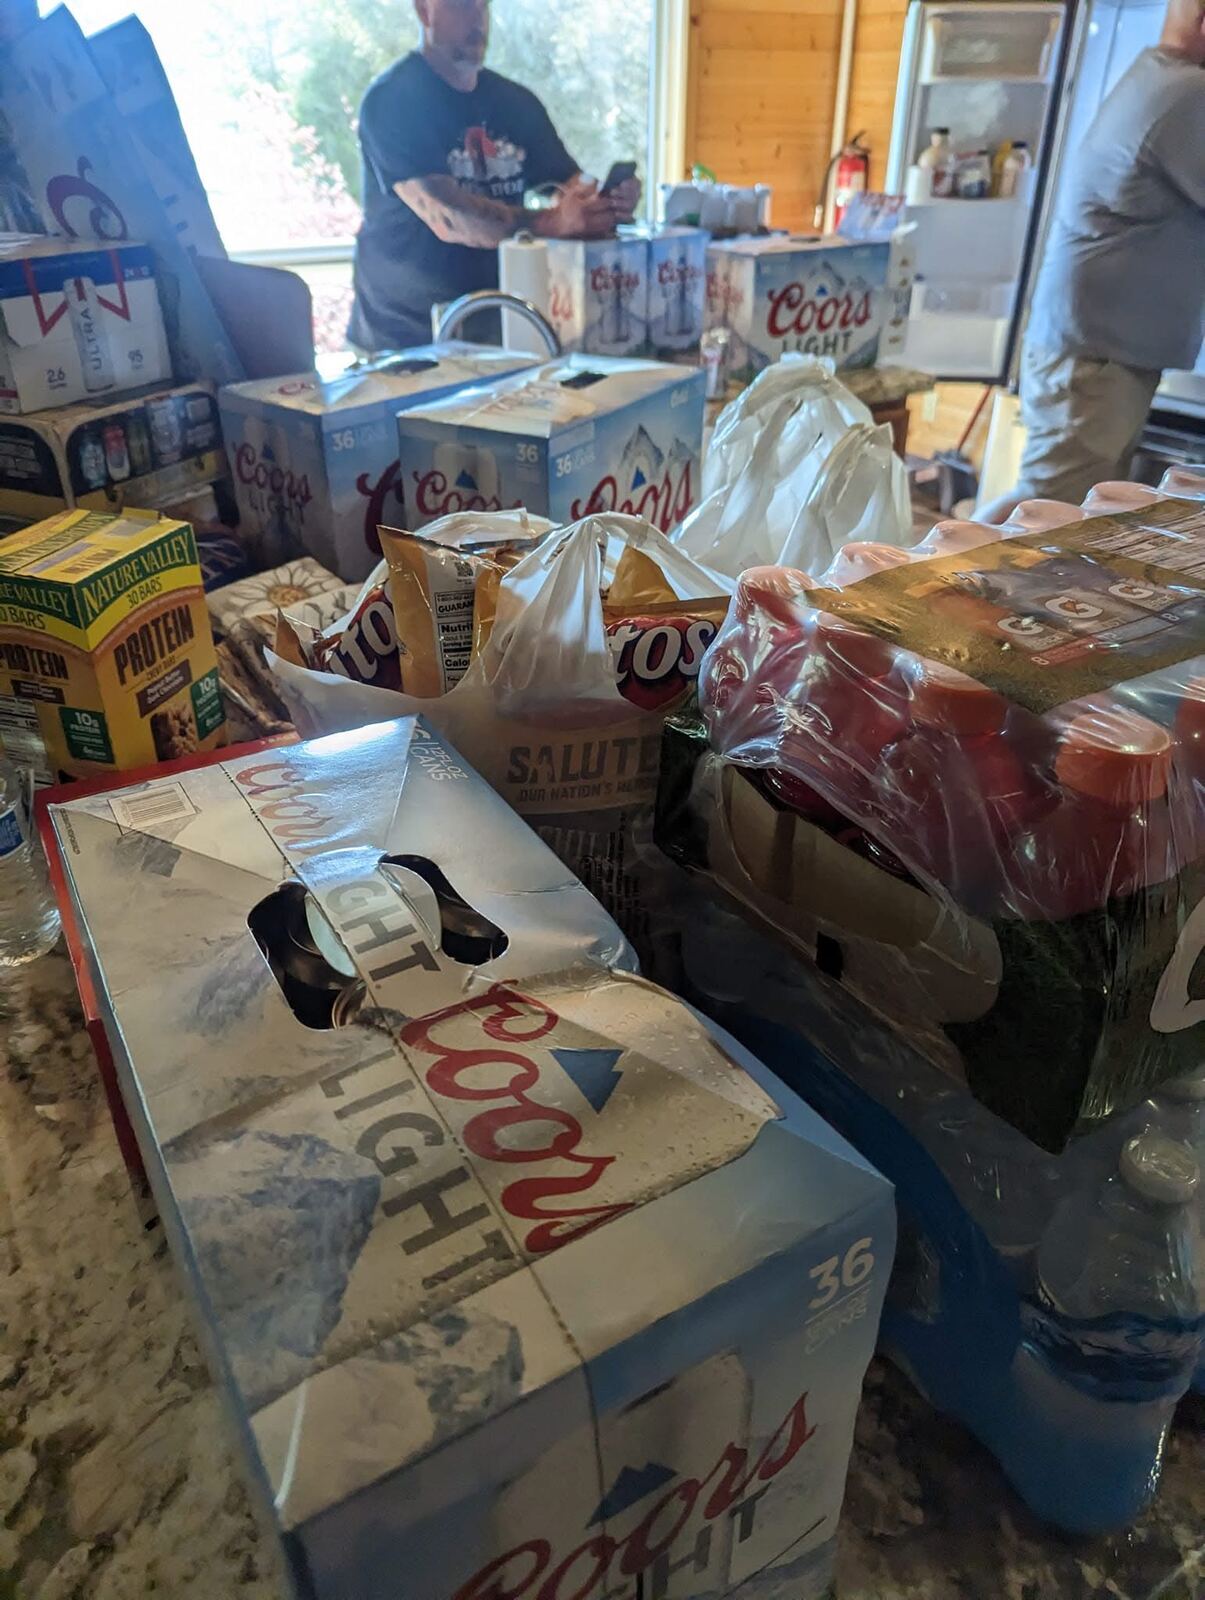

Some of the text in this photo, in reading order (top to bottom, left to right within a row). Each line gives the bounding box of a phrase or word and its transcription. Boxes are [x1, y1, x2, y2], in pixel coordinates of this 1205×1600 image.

[767, 282, 872, 337] Coors
[81, 307, 102, 370] ULTRA
[331, 430, 355, 451] 36
[515, 443, 538, 463] 36
[554, 455, 572, 477] 36
[413, 470, 523, 515] Coor
[81, 558, 146, 622] NATURE
[142, 530, 190, 575] VALLEY
[127, 577, 162, 609] 30 BARS
[8, 606, 46, 631] BARS
[14, 584, 70, 619] VALLEY
[113, 604, 195, 685] PROTEIN
[410, 746, 451, 781] CANS
[507, 735, 660, 784] SALUTE
[551, 782, 613, 800] NATION'S
[326, 879, 442, 980] GHT
[400, 979, 637, 1252] Coors
[318, 1047, 515, 1291] LIGHT
[808, 1237, 875, 1309] 36
